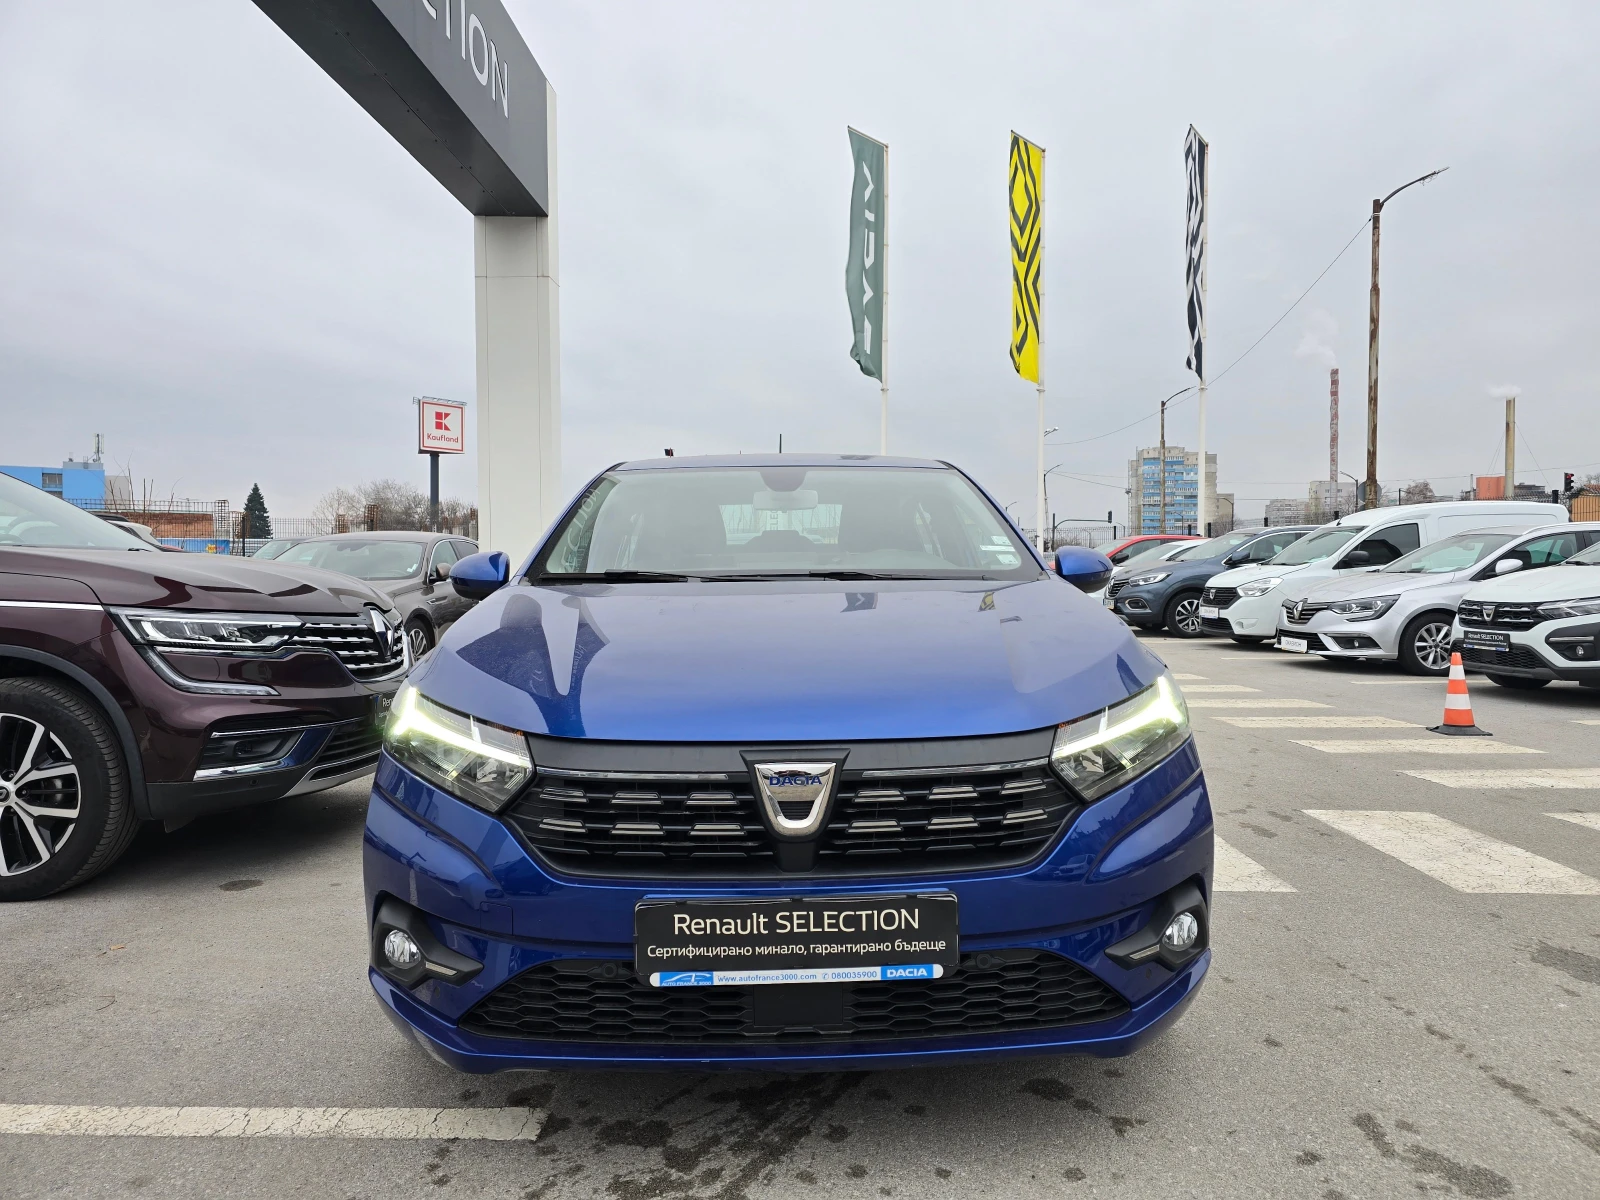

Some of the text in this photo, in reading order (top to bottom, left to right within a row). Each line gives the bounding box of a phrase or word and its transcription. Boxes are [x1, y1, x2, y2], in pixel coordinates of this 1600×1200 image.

[426, 433, 458, 443] Kaufland
[769, 776, 822, 786] DACIA
[673, 908, 919, 934] Renault SELECTION
[647, 939, 946, 959] Сертифицирано минало, гарантирано бъдеще
[717, 970, 878, 983] www.autofrance3000.com 080035900
[887, 967, 927, 977] DACIA
